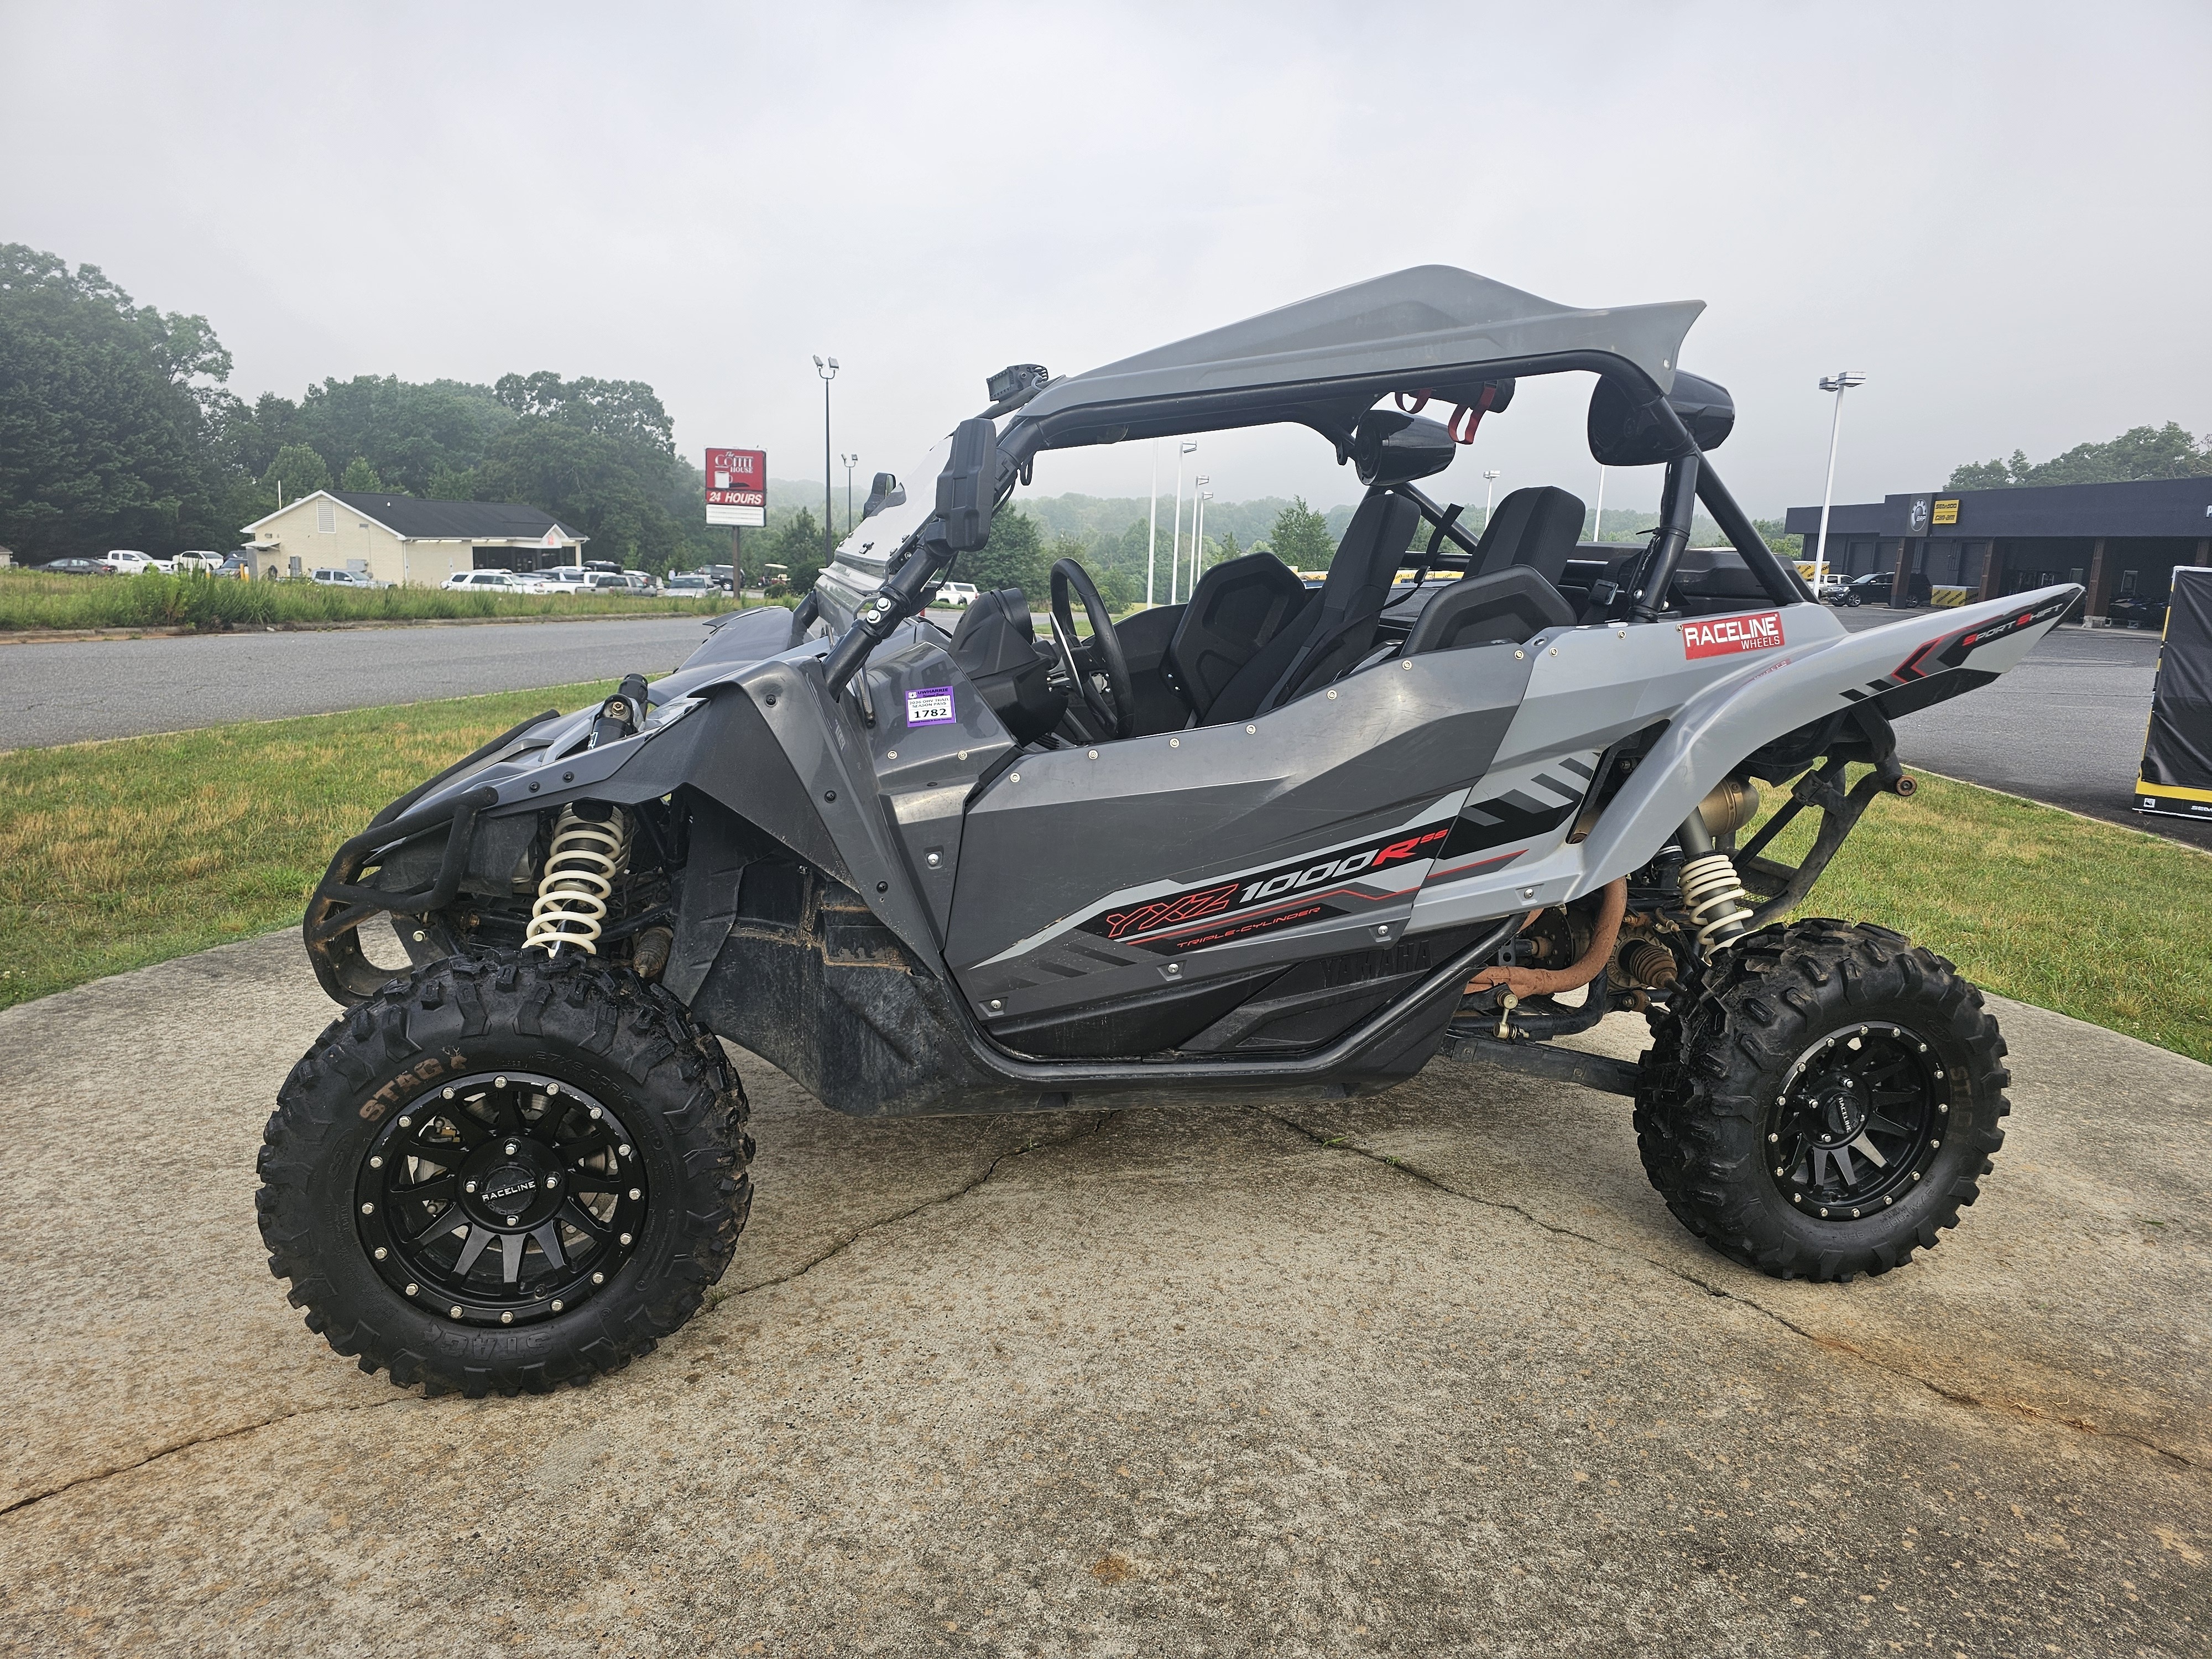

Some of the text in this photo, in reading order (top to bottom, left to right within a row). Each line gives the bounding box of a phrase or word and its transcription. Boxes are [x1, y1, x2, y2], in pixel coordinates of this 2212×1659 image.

[709, 492, 763, 504] 24 HOURS
[1684, 616, 1779, 647] RACELINE
[1962, 603, 2063, 646] SPORT SHIFT
[1741, 636, 1780, 650] WHEELS
[914, 708, 947, 718] 1782
[1107, 884, 1239, 938] YXZ
[1177, 907, 1321, 948] TRIPLE-CYLINDER
[1319, 940, 1432, 988] YAMAHA
[359, 1058, 444, 1121] STAG
[1838, 1097, 1852, 1133] RACELINE
[482, 1181, 536, 1202] RACELINE
[441, 1332, 552, 1360] STAG
